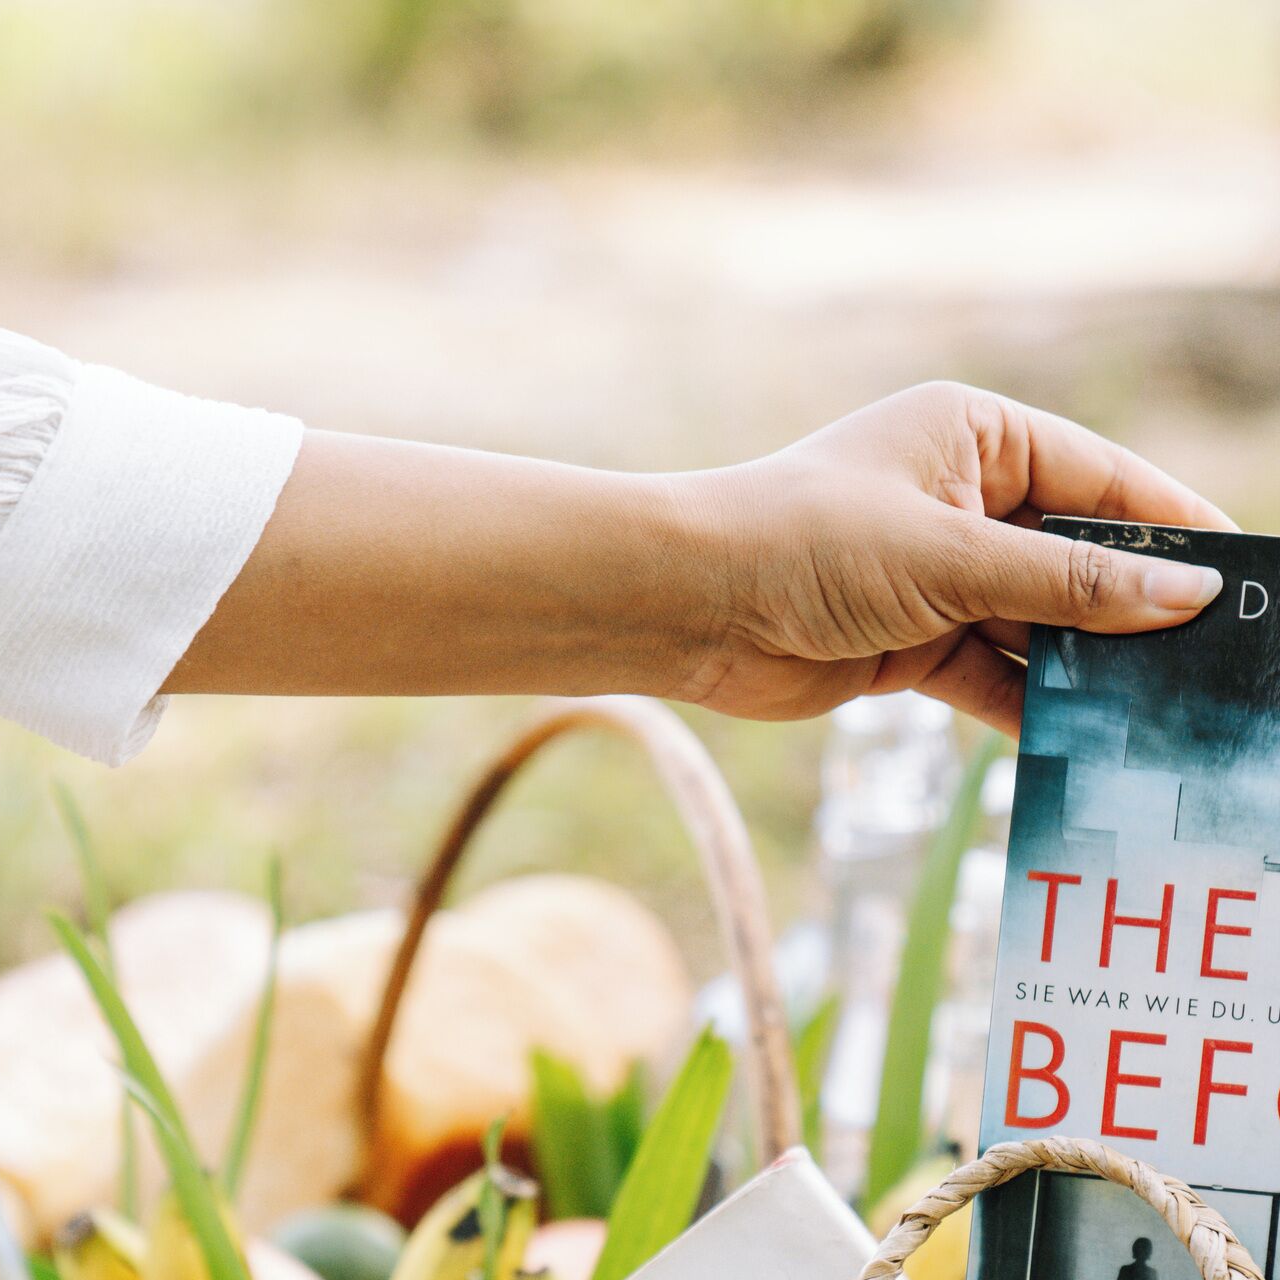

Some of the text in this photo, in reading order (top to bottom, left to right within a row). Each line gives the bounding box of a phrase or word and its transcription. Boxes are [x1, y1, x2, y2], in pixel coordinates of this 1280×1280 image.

[1027, 869, 1257, 982] THE
[1015, 981, 1055, 1004] SIE
[1068, 986, 1130, 1011] WAR
[1144, 993, 1199, 1017] WIE
[1211, 1000, 1255, 1023] DU.
